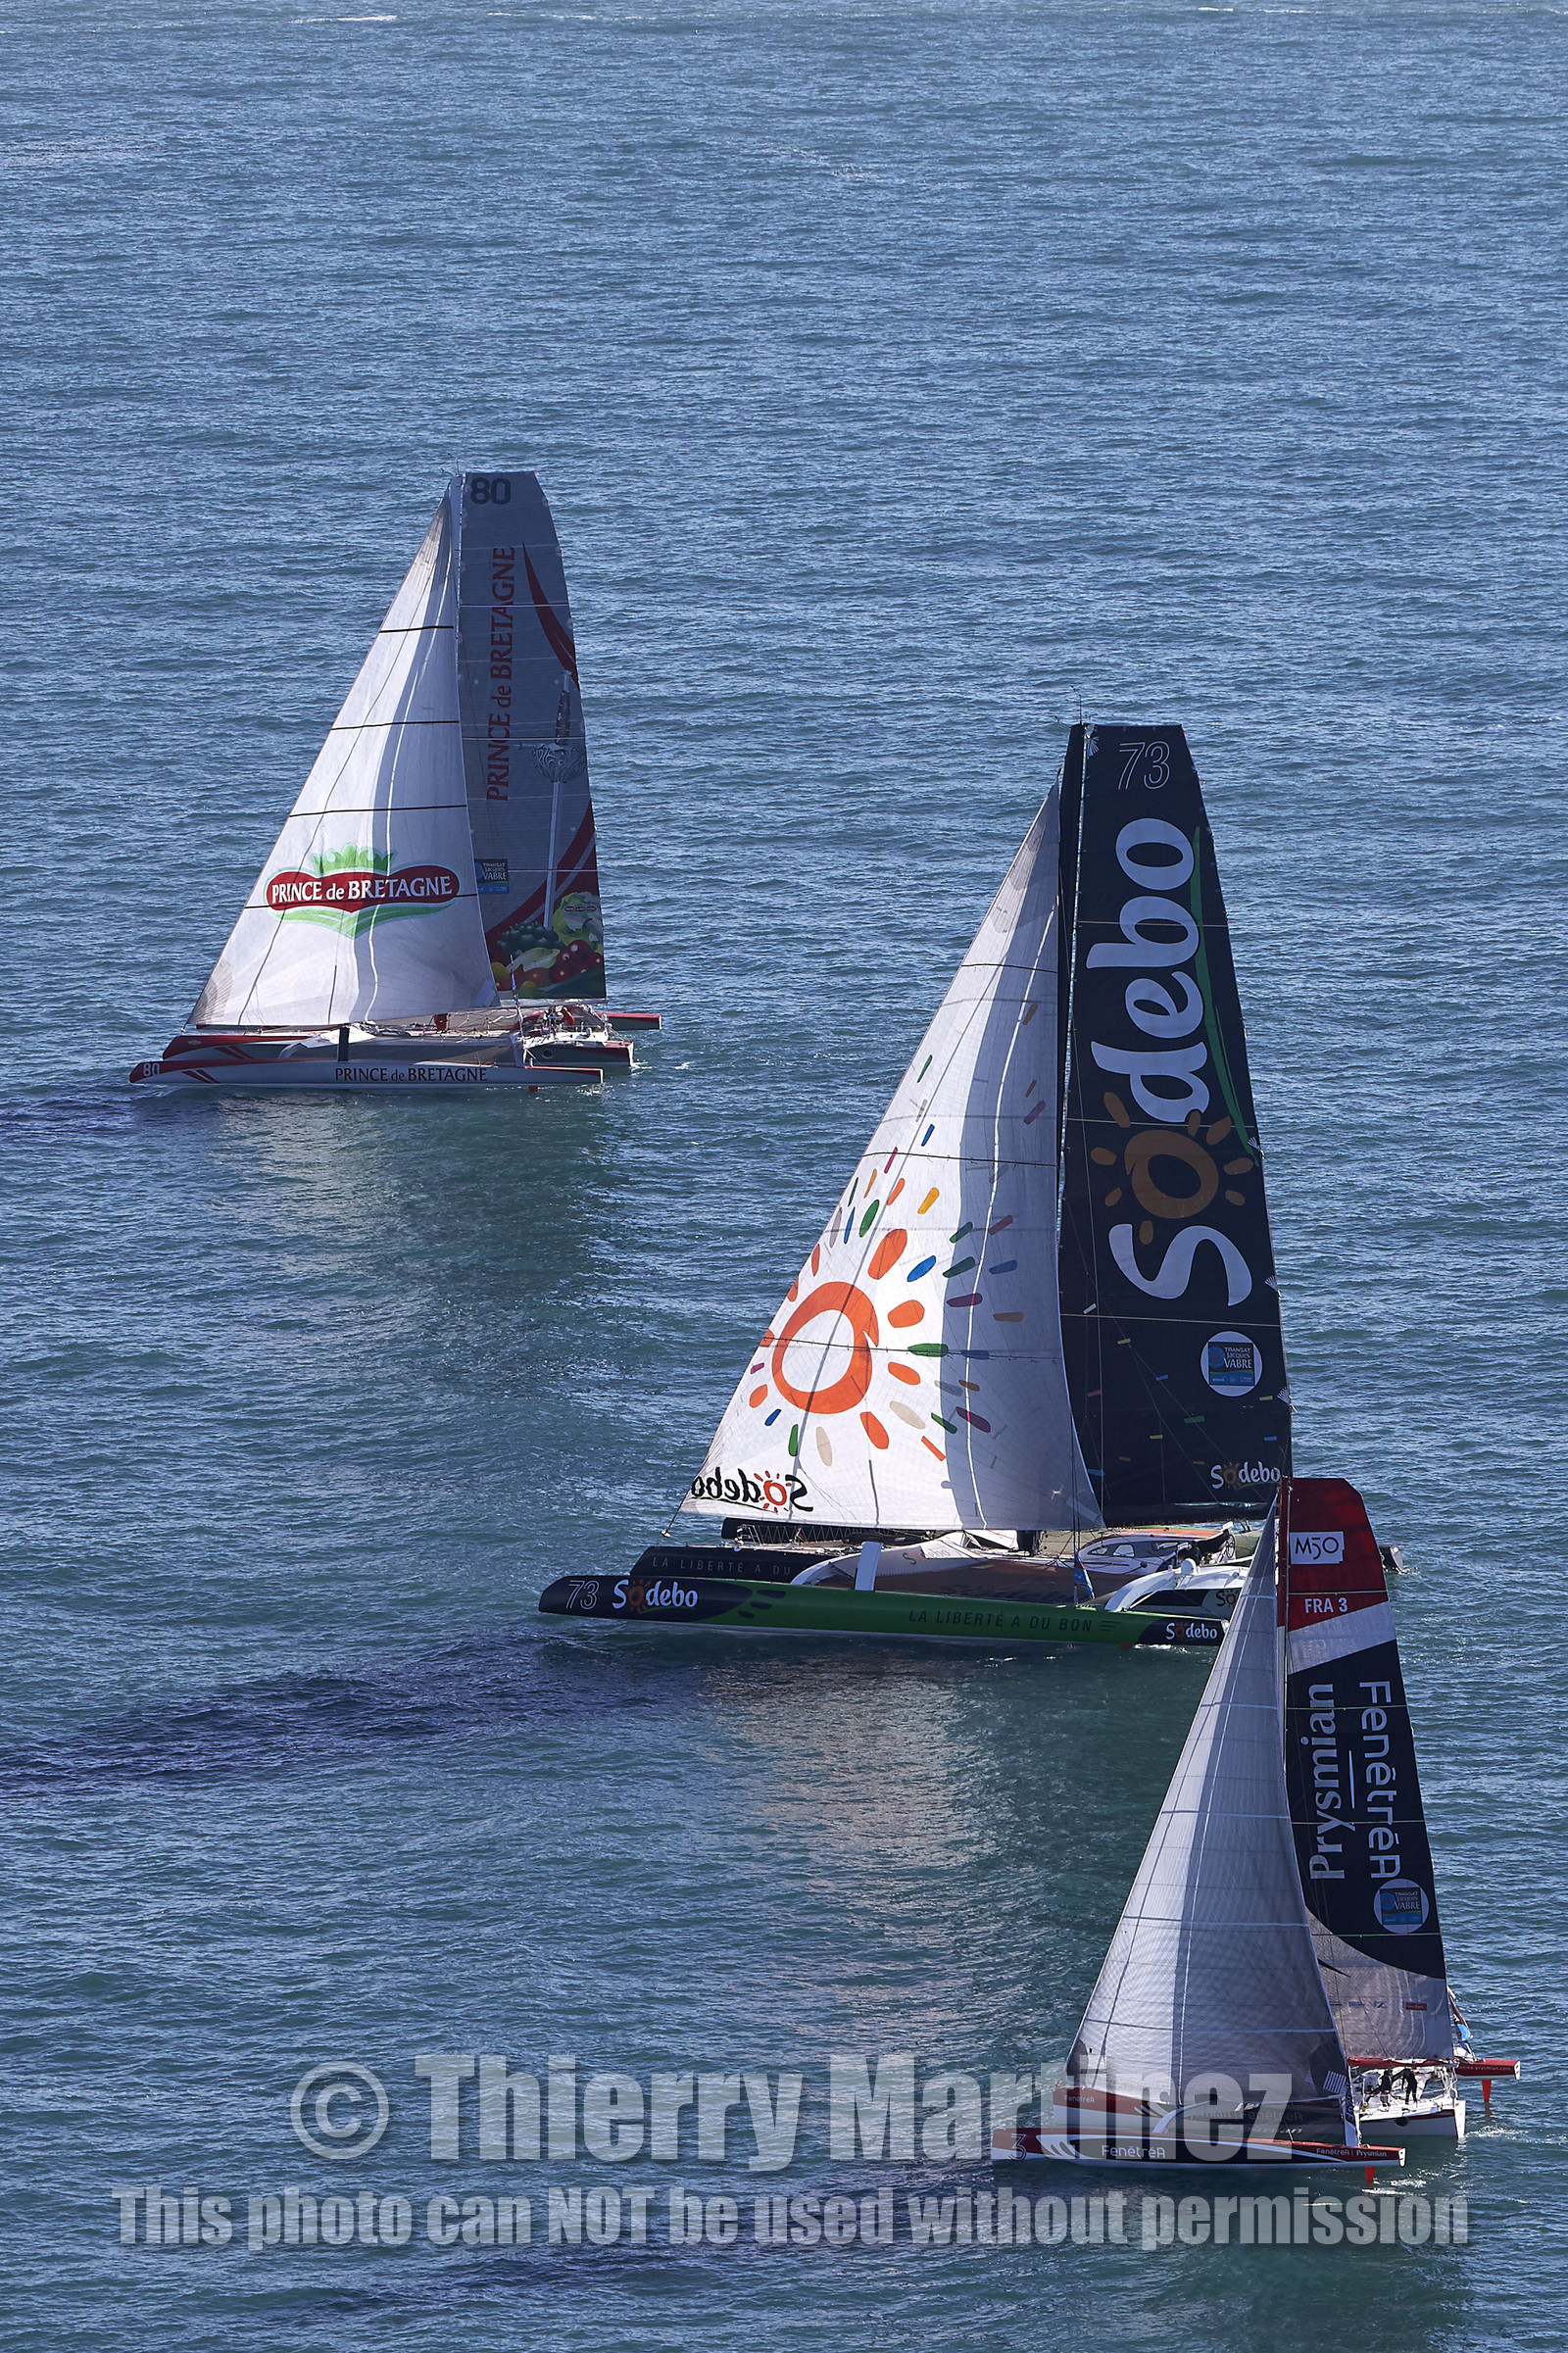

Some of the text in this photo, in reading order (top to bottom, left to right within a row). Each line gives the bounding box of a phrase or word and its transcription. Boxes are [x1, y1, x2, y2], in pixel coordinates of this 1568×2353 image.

[469, 476, 512, 505] 80
[486, 546, 515, 802] PRINCE de BRETAGNE
[1117, 740, 1172, 791] 73
[482, 871, 508, 881] VABRE
[271, 875, 453, 905] PRINCE de BRETAGNE
[142, 1062, 160, 1077] 80
[334, 1066, 488, 1082] PRINCE de BRETAGNE
[1223, 1357, 1253, 1369] VABRE
[1295, 1536, 1340, 1560] M50
[652, 1556, 669, 1568] LA
[754, 1561, 762, 1574] A
[772, 1562, 792, 1576] DU
[564, 1579, 600, 1610] 73
[1304, 1596, 1348, 1614] FRA 3
[908, 1609, 1093, 1633] LA LIBERTÉ A DU BON
[1300, 1683, 1356, 1880] Prysmian
[1394, 1900, 1421, 1910] VABRE
[1007, 2132, 1027, 2161] 3
[1355, 2149, 1388, 2159] Prysmian
